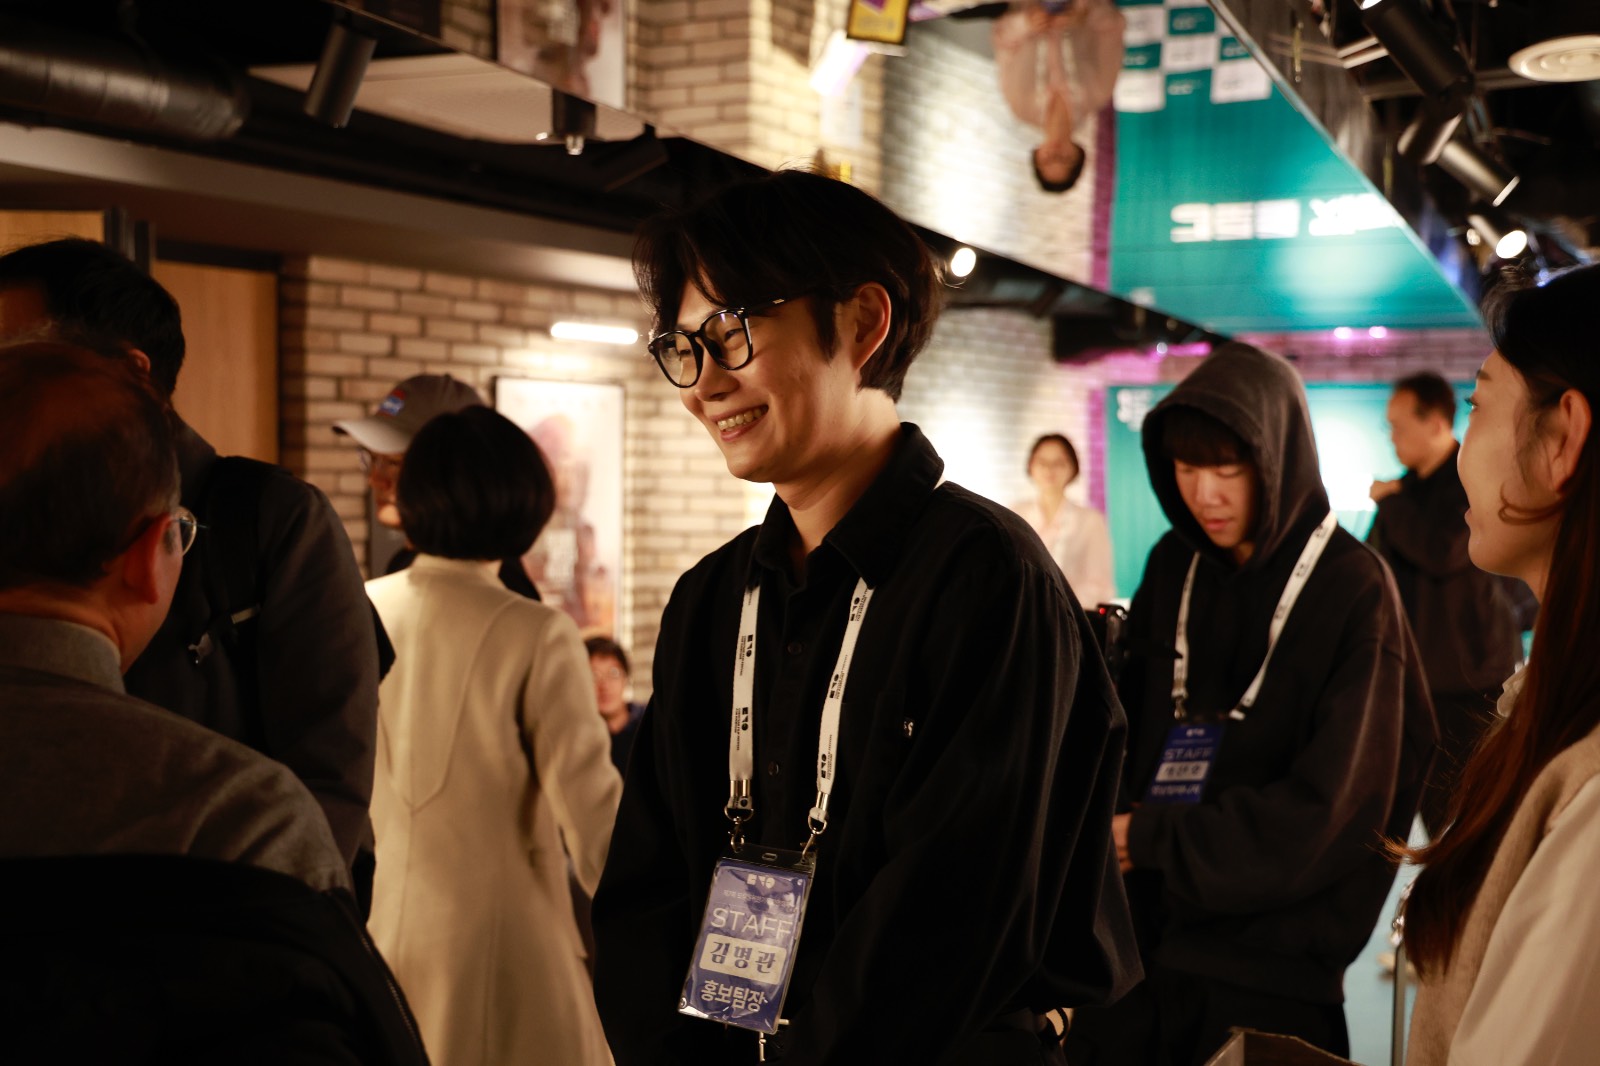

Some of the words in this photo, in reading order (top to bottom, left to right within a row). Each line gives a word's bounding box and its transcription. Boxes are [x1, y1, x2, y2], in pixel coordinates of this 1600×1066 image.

[710, 907, 793, 939] STAFF
[710, 942, 776, 974] 김병관
[701, 980, 768, 1012] 홍보팀장
